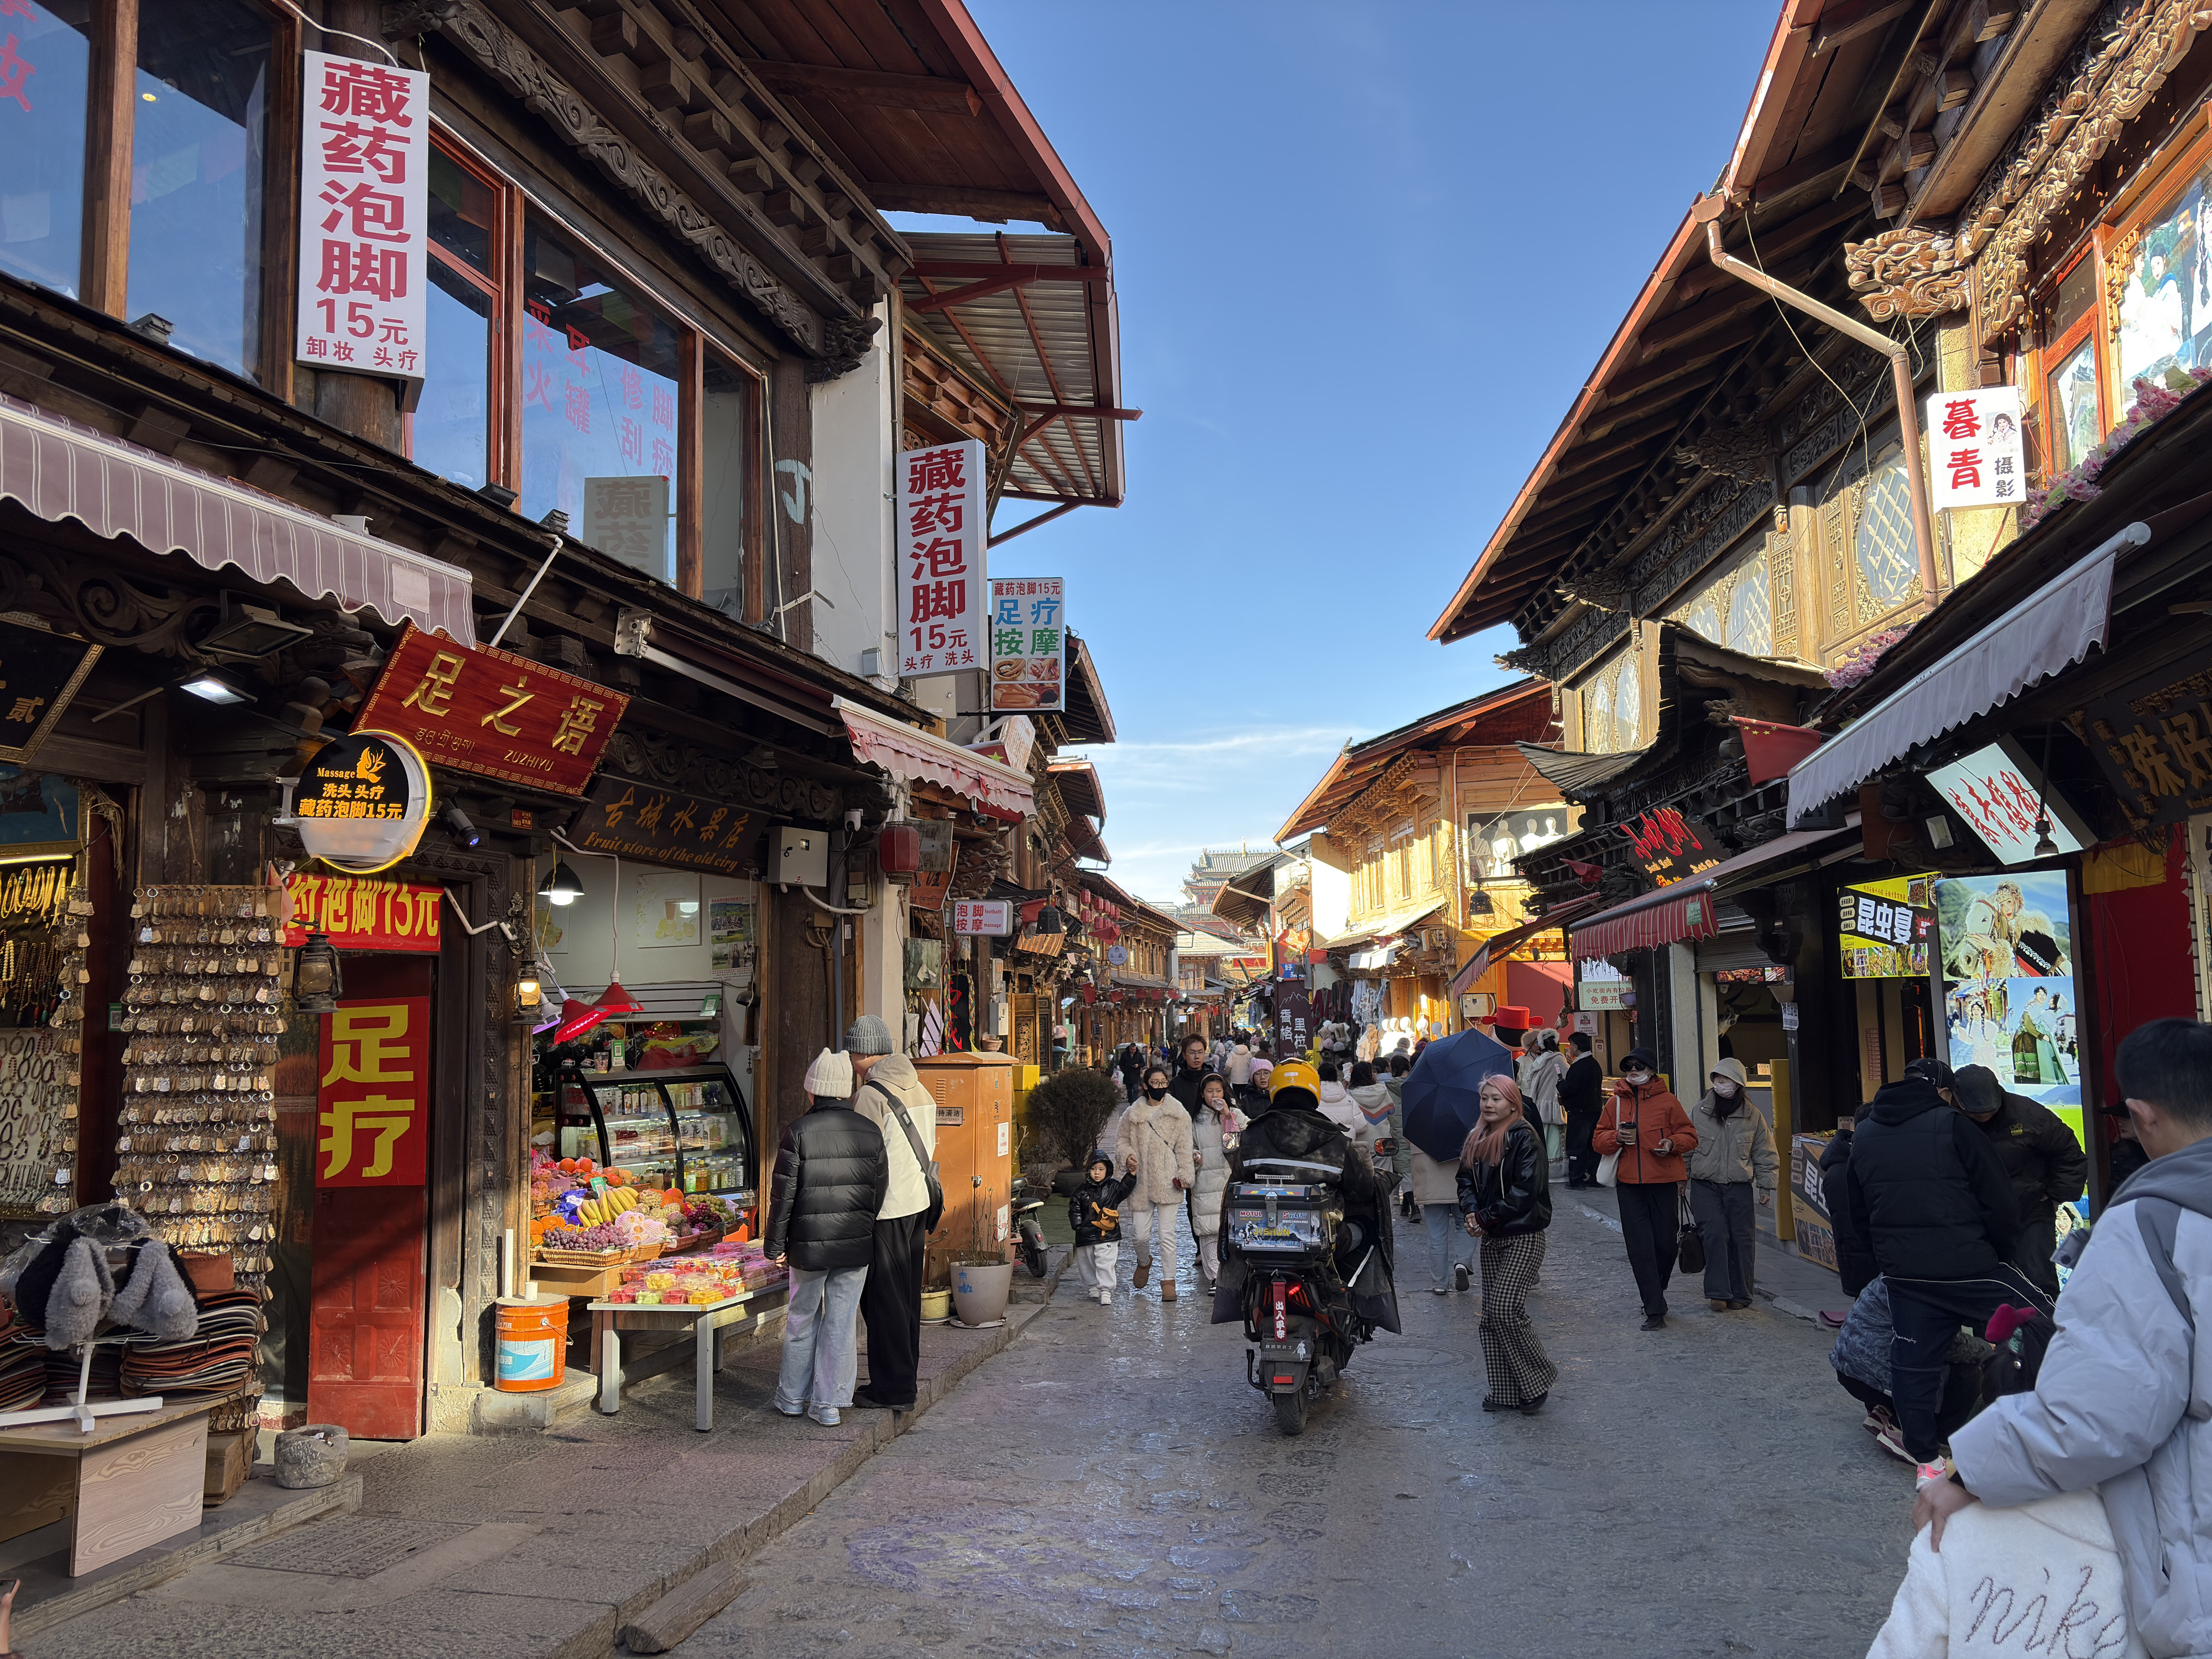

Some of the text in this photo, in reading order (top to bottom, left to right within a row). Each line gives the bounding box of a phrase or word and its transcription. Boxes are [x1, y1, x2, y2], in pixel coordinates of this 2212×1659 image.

[316, 61, 413, 302] 藏药泡脚
[316, 298, 409, 346] 15元
[306, 336, 419, 372] 卸妆 头疗
[1942, 398, 1983, 489] 暮青
[1995, 456, 2015, 498] 摄影
[907, 448, 967, 624] 藏药泡脚
[994, 581, 1061, 596] 藏药泡脚15元
[994, 597, 1060, 625] 足疗
[910, 623, 968, 652] 15元
[994, 628, 1060, 656] 按摩
[904, 649, 974, 671] 头疗 洗头
[401, 649, 604, 757] 足之语
[317, 767, 356, 780] Massage
[503, 749, 555, 771] ZUZHIYU
[322, 783, 385, 800] 洗头 头疗
[299, 799, 403, 820] 藏药泡脚15元
[605, 785, 749, 849] 古城水果店
[583, 831, 623, 851] Fruit
[622, 840, 658, 855] store
[658, 846, 674, 862] of
[674, 848, 694, 863] the
[695, 851, 716, 865] old
[956, 919, 983, 931] 按摩
[957, 904, 984, 917] 泡脚
[1857, 897, 1913, 945] 昆虫宴
[320, 1004, 415, 1180] 足疗
[936, 1109, 960, 1117] 持清洁
[1253, 1227, 1290, 1237] JISHUN
[1275, 1301, 1285, 1339] 出入平安
